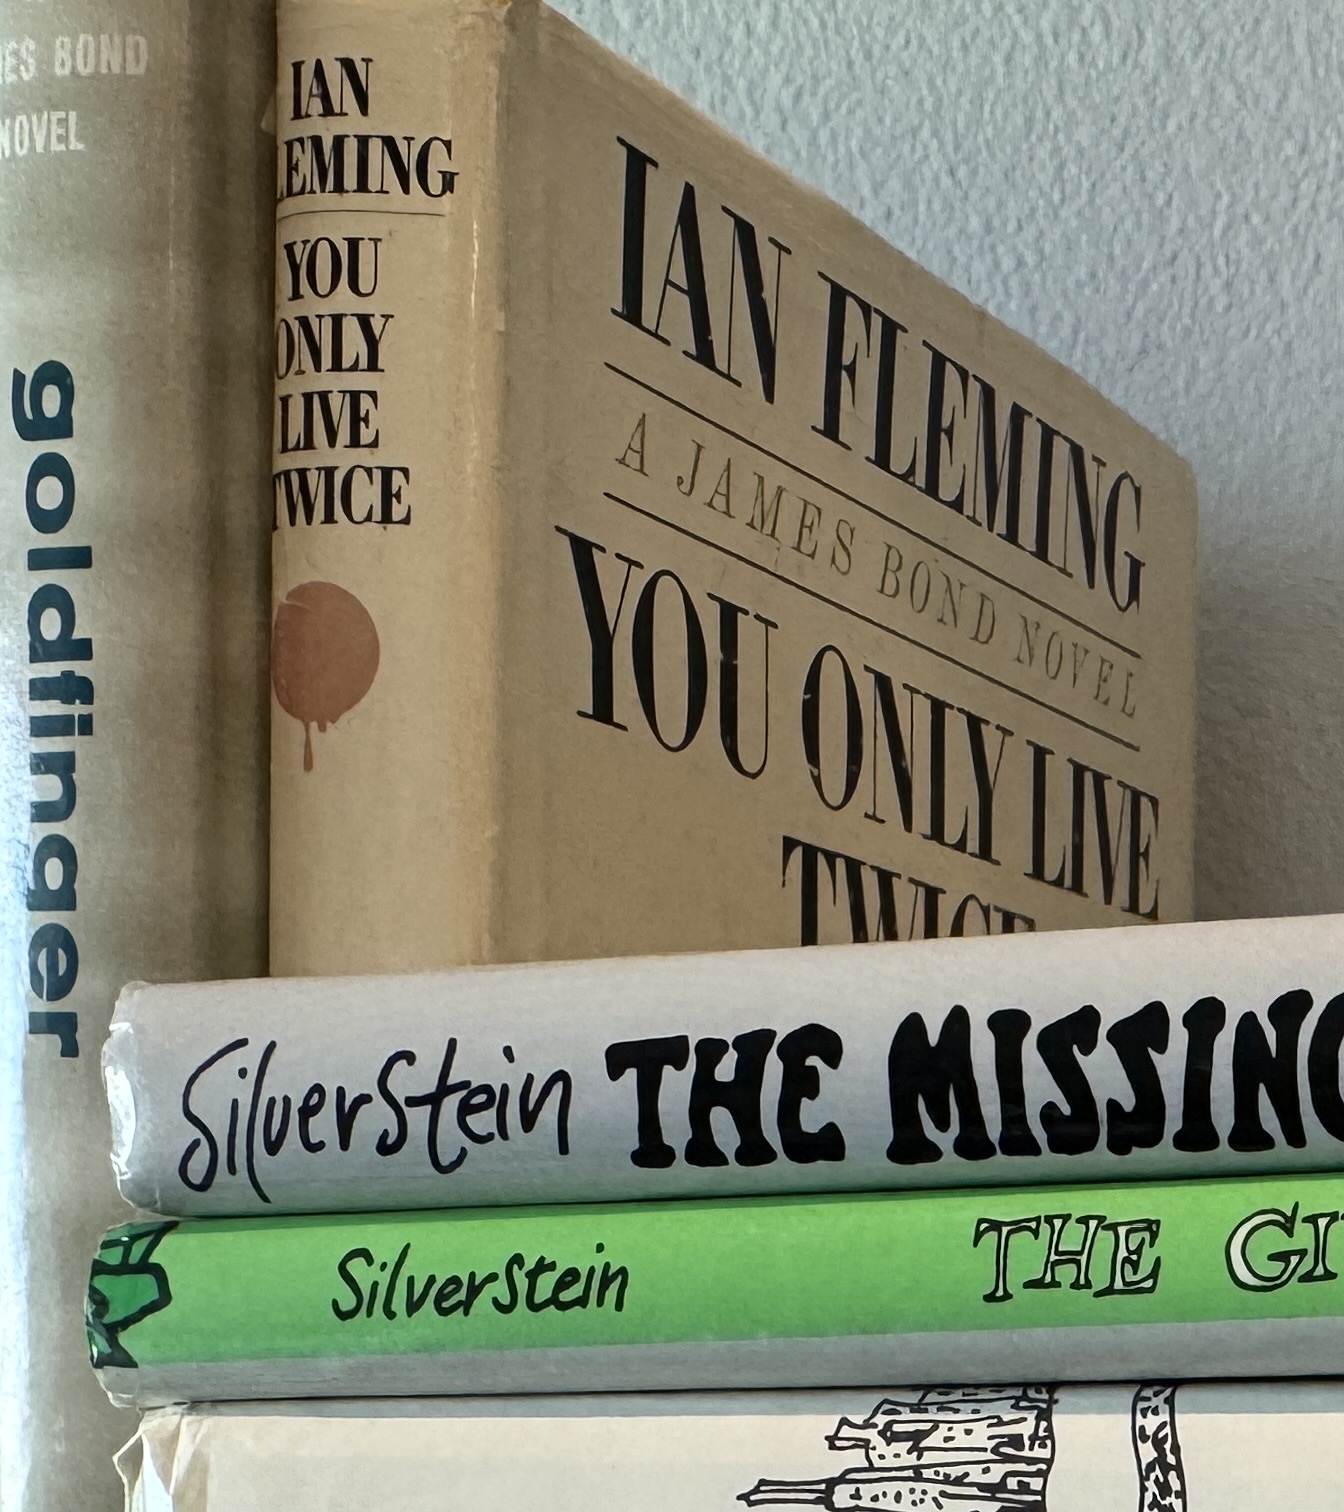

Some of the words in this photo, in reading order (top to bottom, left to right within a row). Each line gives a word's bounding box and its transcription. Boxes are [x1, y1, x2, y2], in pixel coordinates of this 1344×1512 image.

[0, 35, 37, 85] ES
[54, 33, 149, 76] BOND
[290, 57, 374, 121] IAN
[277, 134, 460, 200] EMING
[284, 236, 383, 301] YOU
[275, 313, 395, 380] ONLY
[610, 136, 793, 404] IAN
[811, 271, 1147, 614] FLEMING
[279, 390, 379, 454] LIVE
[615, 412, 650, 477] A
[676, 438, 857, 577] JAMES
[876, 541, 997, 646] BOND
[1016, 612, 1139, 721] NOVEL
[554, 525, 779, 780] YOU
[801, 645, 1014, 866] ONLY
[1023, 740, 1161, 921] LIVE
[178, 1037, 573, 1205] Silverstein
[605, 1024, 845, 1169] THE
[332, 1243, 628, 1321] Silverstein
[973, 1213, 1161, 1303] THE
